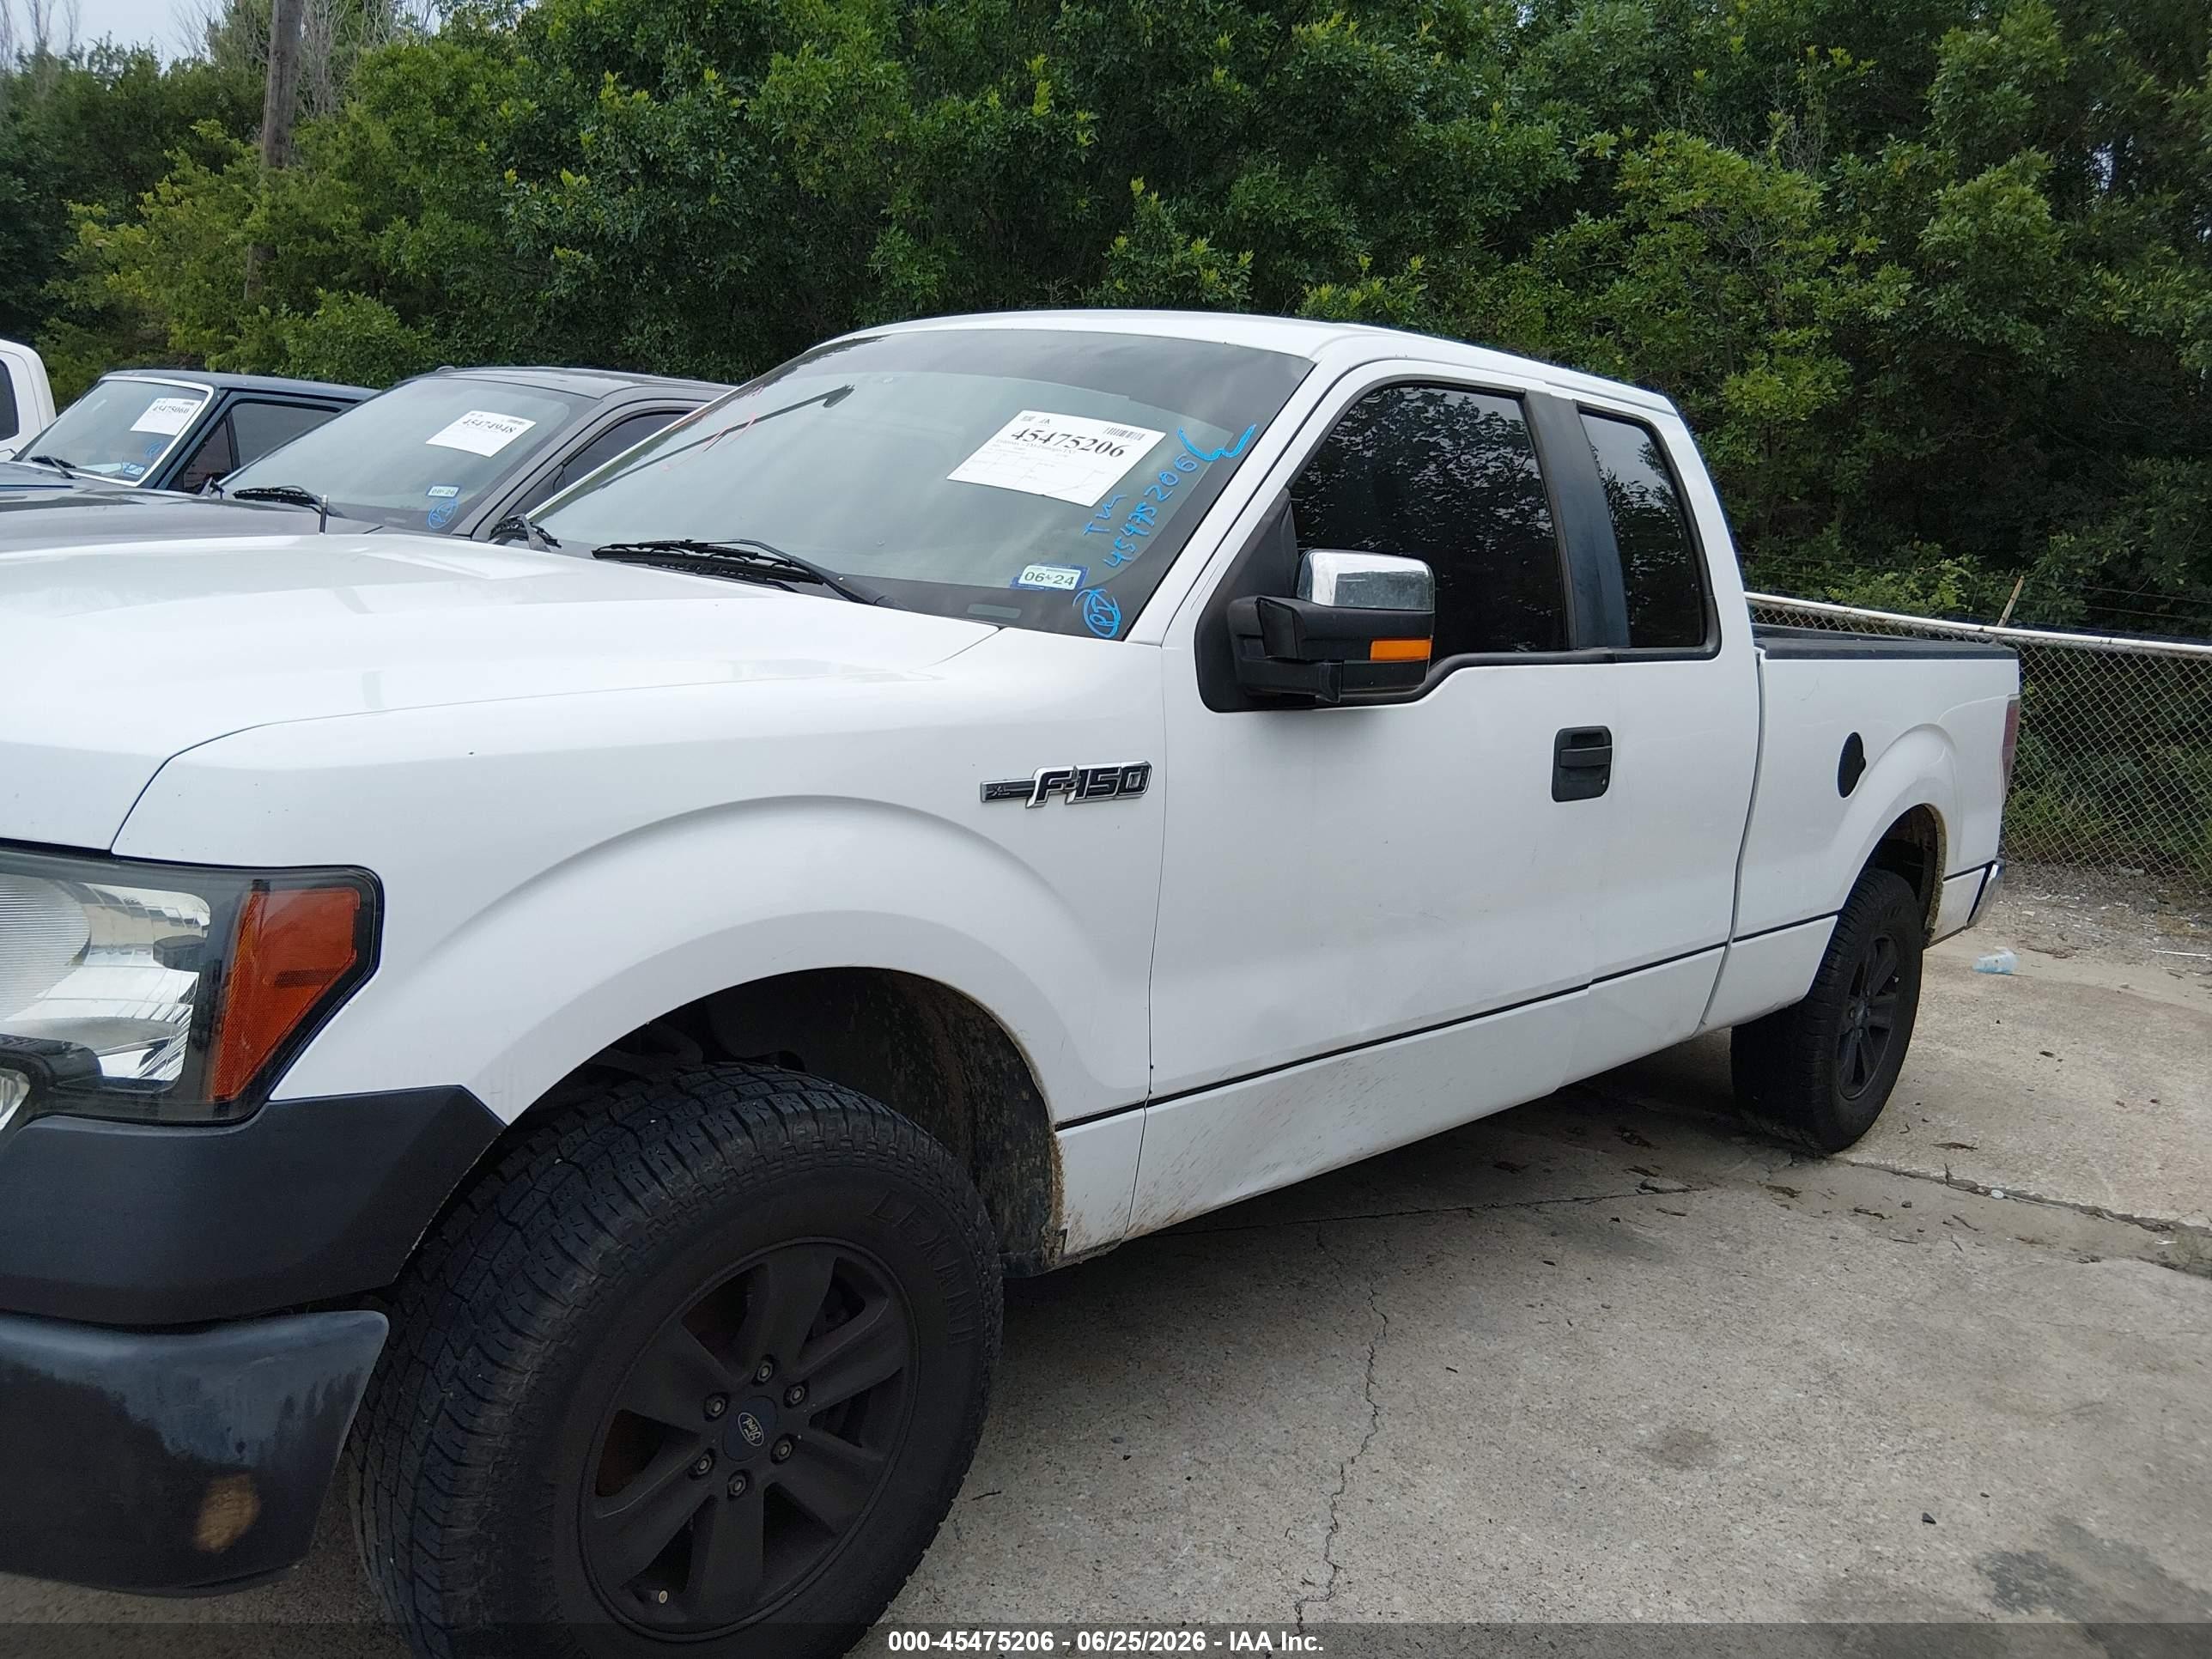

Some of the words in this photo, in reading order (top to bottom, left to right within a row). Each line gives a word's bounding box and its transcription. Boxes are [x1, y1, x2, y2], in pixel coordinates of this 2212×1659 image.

[1011, 428, 1130, 458] 45475206
[1024, 571, 1045, 583] 06
[1053, 574, 1075, 586] 24
[742, 1416, 762, 1441] Ford
